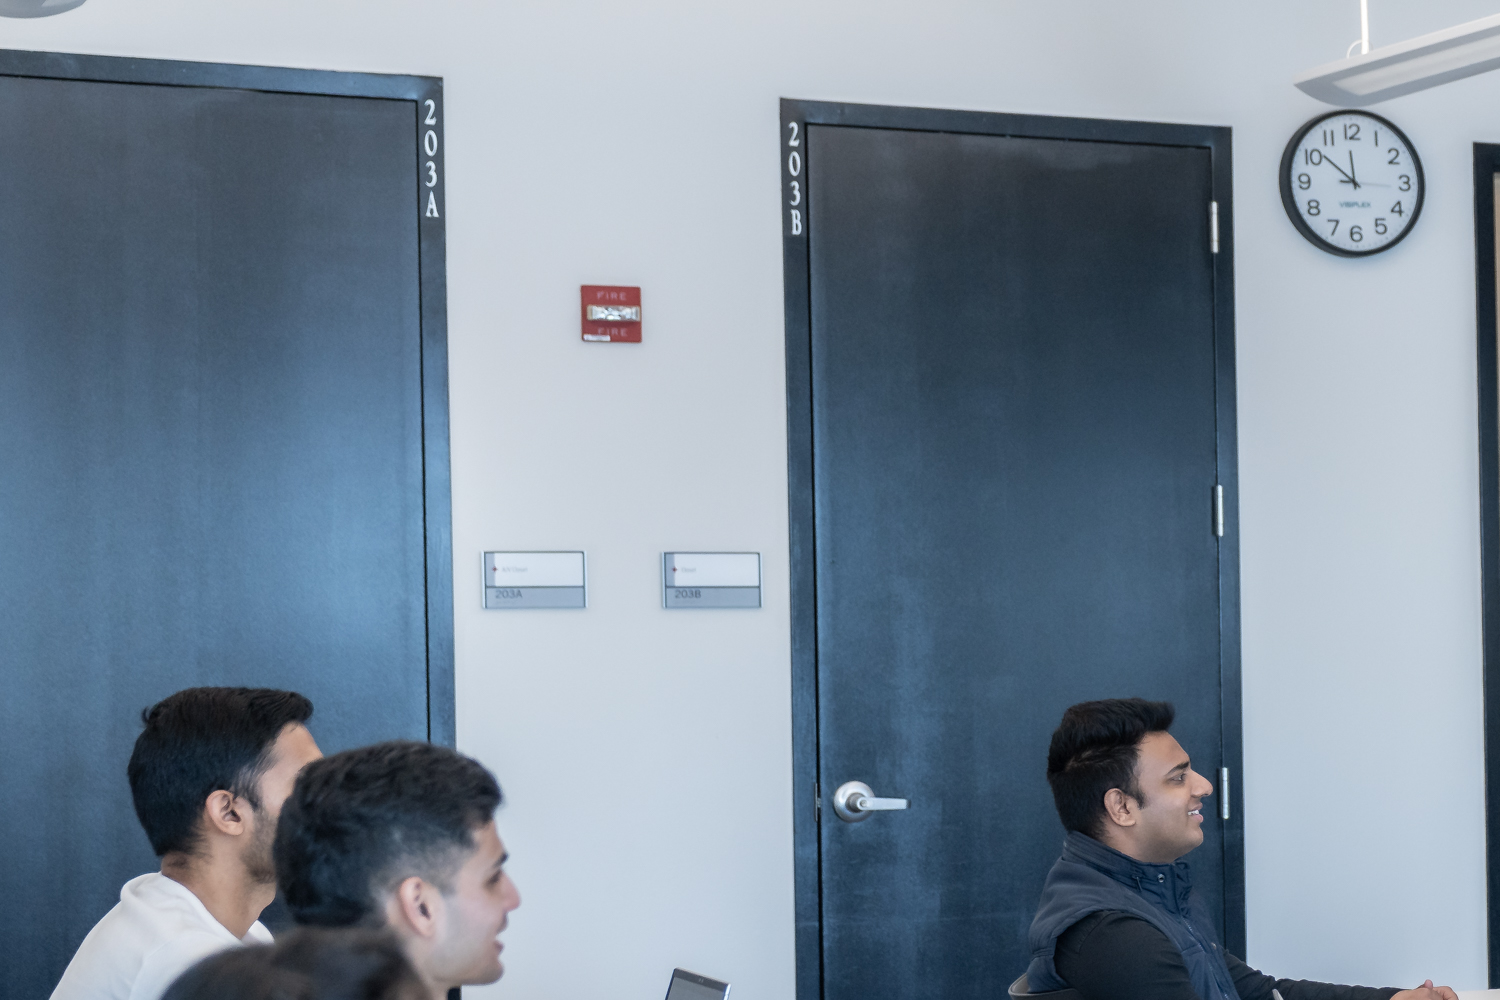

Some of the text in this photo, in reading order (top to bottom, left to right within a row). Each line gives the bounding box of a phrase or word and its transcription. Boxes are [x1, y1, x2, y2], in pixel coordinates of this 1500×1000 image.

[1323, 129, 1335, 146] 11
[1344, 123, 1361, 141] 12
[1374, 130, 1379, 147] 1
[424, 99, 440, 218] 203A
[1305, 148, 1323, 166] 10
[1387, 148, 1400, 165] 2
[788, 121, 802, 236] 203B
[1297, 173, 1312, 191] 9
[1398, 174, 1411, 192] 3
[1307, 199, 1321, 217] 8
[1390, 200, 1404, 217] 4
[1327, 219, 1340, 237] 7
[1350, 225, 1363, 243] 6
[1374, 217, 1388, 235] 5
[596, 291, 627, 301] FIRE
[598, 327, 628, 337] FIRE
[495, 589, 523, 599] 203A
[674, 589, 702, 599] 203B
